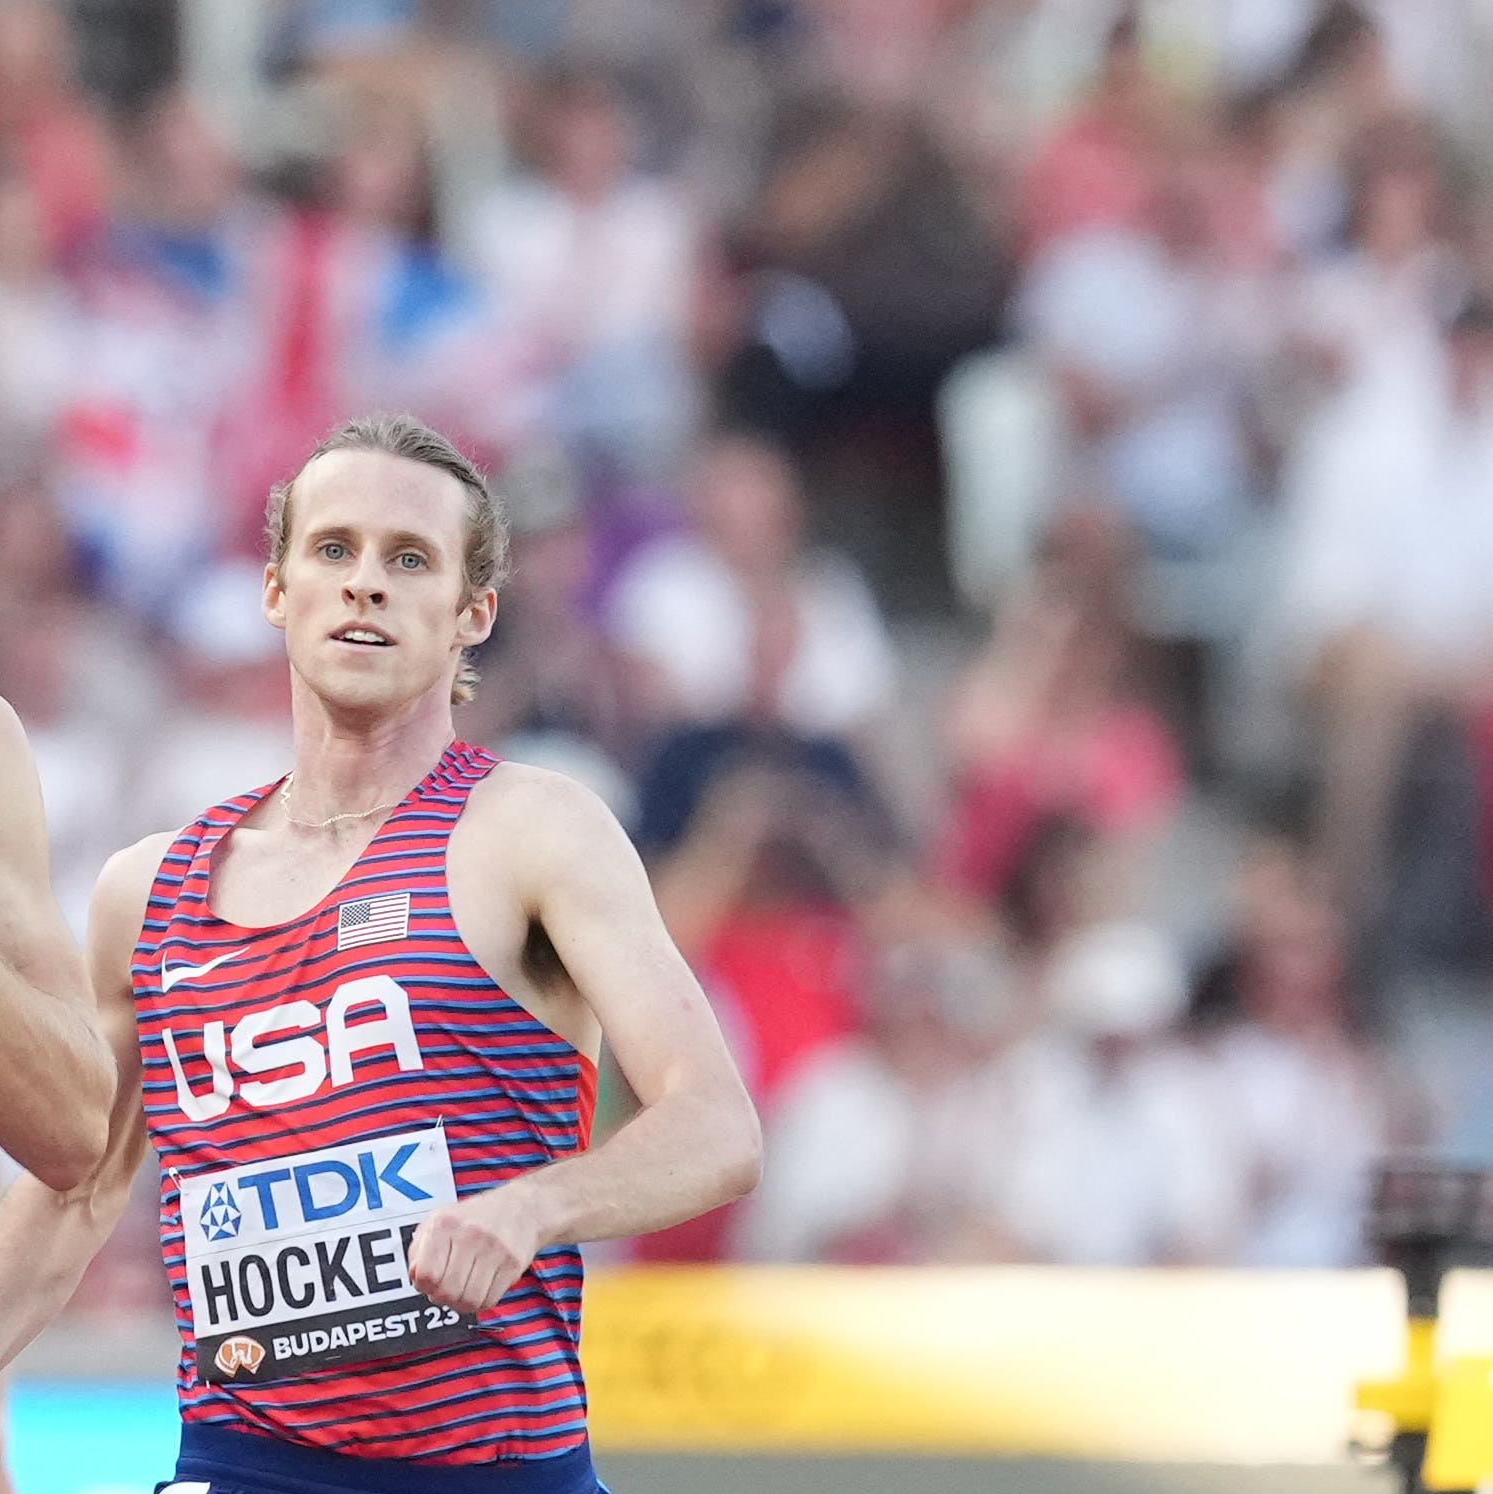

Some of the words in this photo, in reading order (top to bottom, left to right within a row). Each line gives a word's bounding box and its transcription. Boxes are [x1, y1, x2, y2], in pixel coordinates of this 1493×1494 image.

[162, 974, 424, 1122] USA
[238, 1141, 433, 1232] TDK
[273, 1310, 420, 1360] BUDAPEST
[423, 1304, 460, 1330] 23
